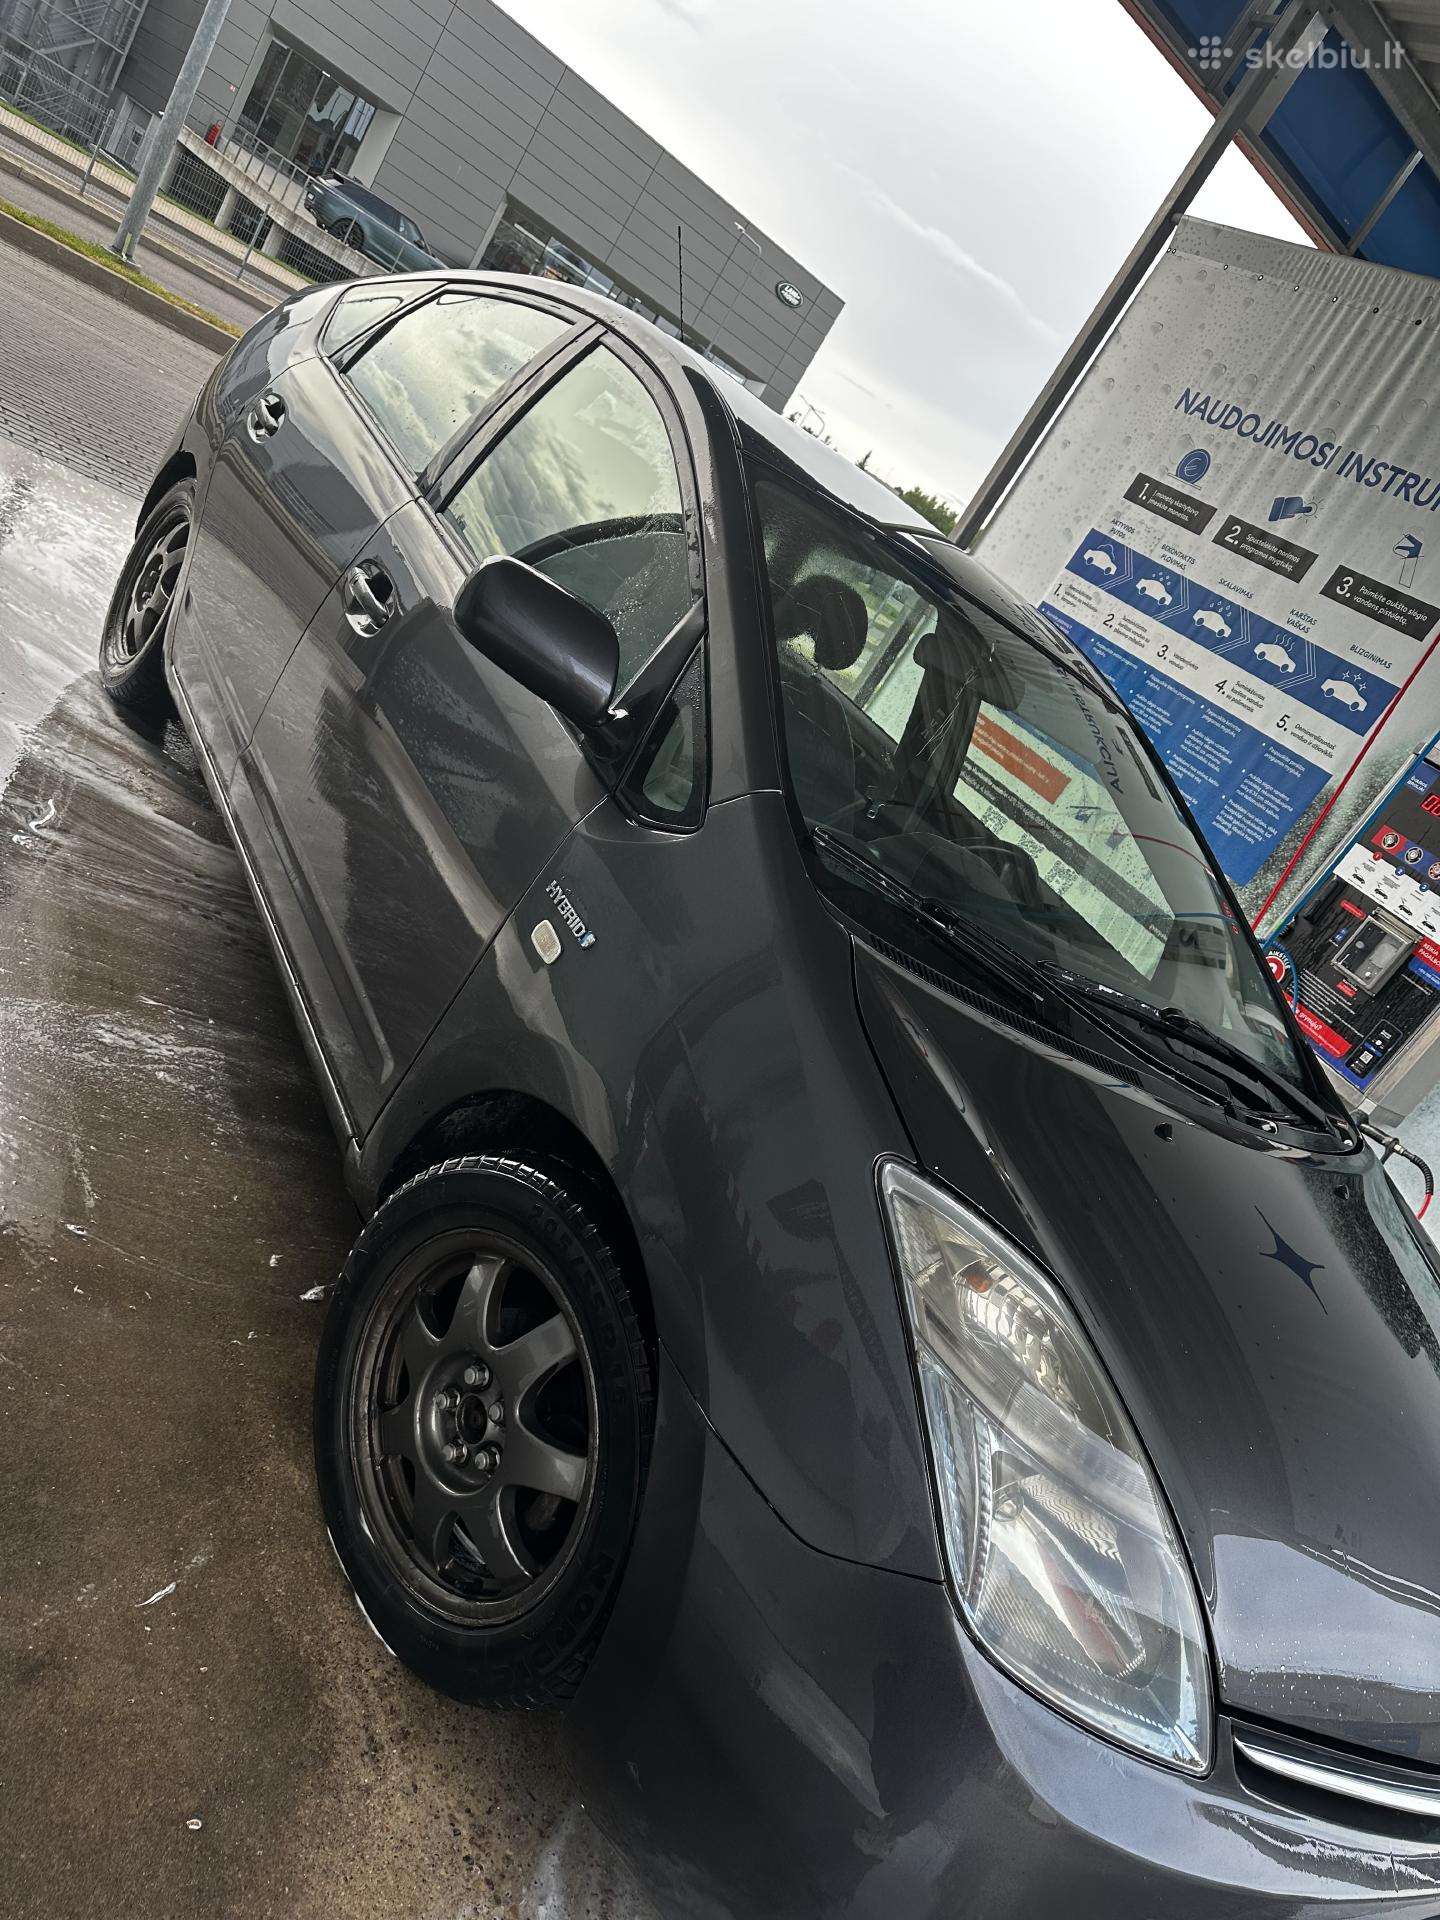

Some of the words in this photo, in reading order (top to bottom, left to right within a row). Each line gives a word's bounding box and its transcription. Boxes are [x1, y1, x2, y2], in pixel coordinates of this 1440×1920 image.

[1174, 387, 1342, 470] NAUDOJIMOSI
[1336, 450, 1440, 511] INSTRU
[1138, 482, 1149, 500] 1.
[1225, 525, 1242, 545] 2.
[1160, 553, 1187, 571] PLOVIMAS
[1053, 583, 1064, 597] 1.
[1217, 577, 1255, 600] SKALAVIMAS
[1336, 576, 1354, 598] 3.
[1359, 585, 1386, 603] Paimkite
[1353, 595, 1379, 612] vandens
[1103, 613, 1115, 629] 2.
[1286, 618, 1311, 634] VAŠKAS
[1289, 608, 1318, 626] KARŠTAS
[1157, 644, 1170, 660] 3.
[1349, 644, 1393, 669] BLIZGINIMAS
[1214, 679, 1228, 695] 4.
[1276, 713, 1290, 732] 5.
[545, 879, 587, 937] HYBRID
